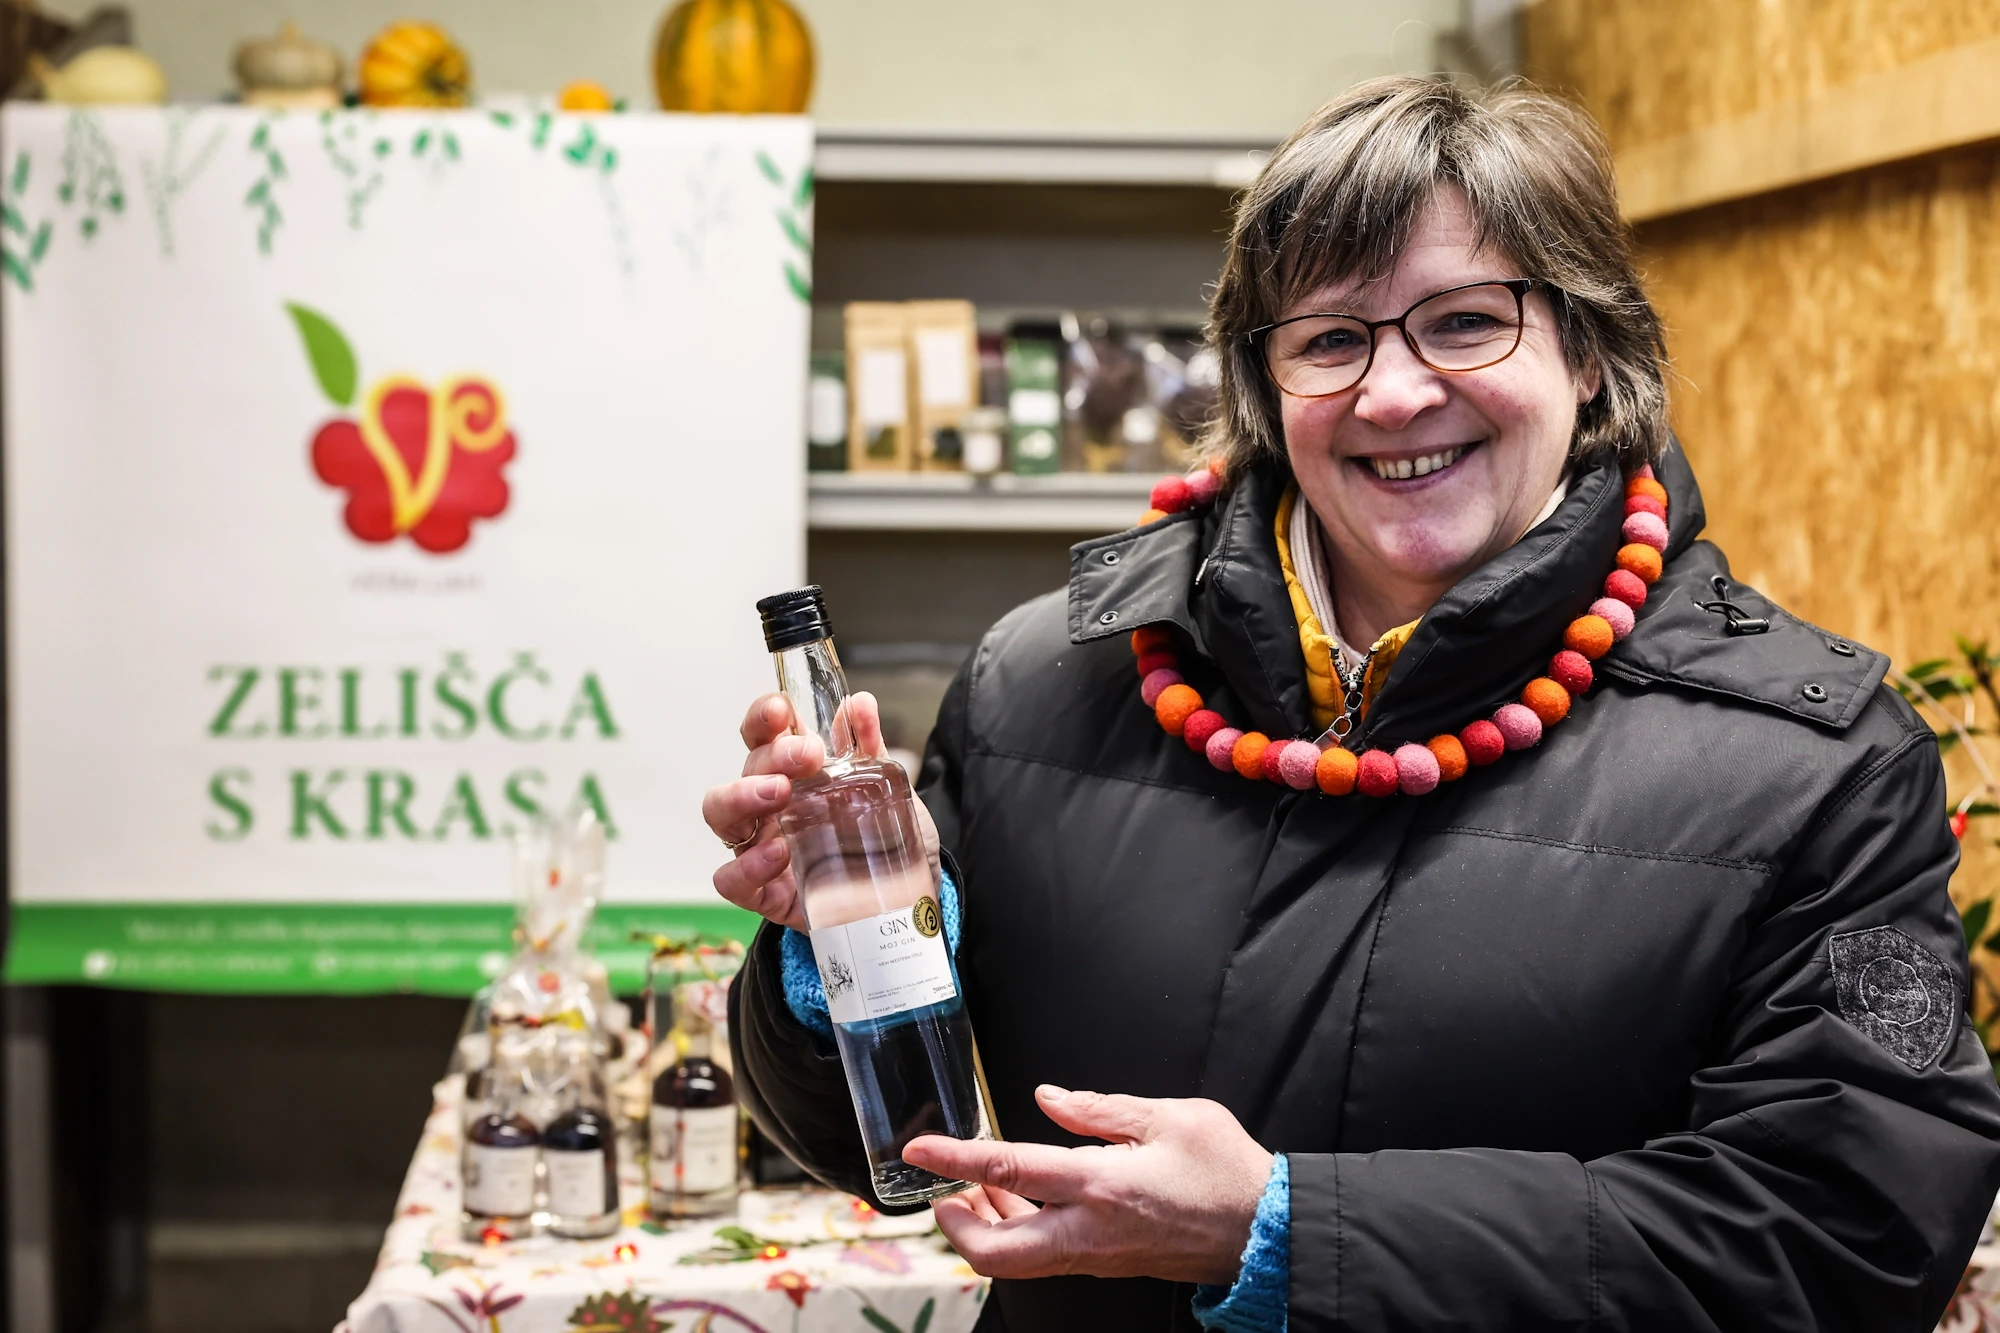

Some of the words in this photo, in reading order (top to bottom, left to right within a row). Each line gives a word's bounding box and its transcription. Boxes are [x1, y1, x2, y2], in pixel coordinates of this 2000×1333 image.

[206, 651, 621, 741] ZELIŠČA
[205, 766, 256, 842] S
[290, 766, 620, 842] KRASA
[880, 917, 908, 936] GIN
[880, 941, 898, 950] MOJ
[901, 937, 915, 945] GIN
